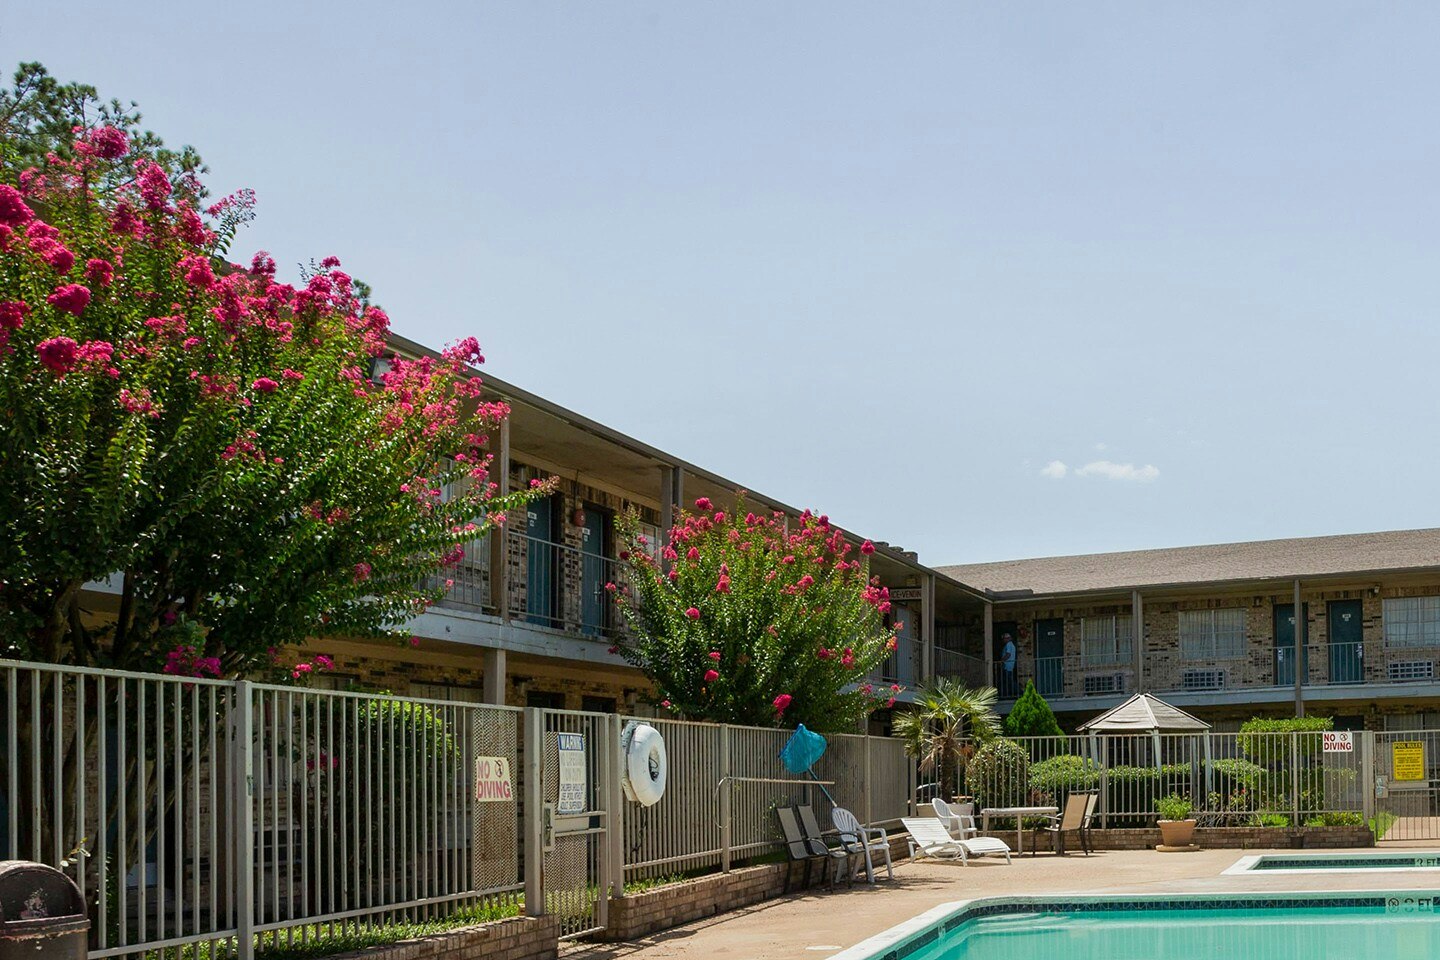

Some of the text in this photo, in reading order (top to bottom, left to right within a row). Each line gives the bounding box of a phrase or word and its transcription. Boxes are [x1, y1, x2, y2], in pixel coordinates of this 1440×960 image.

[1324, 742, 1352, 750] DIVING
[478, 760, 490, 779] NO
[477, 780, 511, 799] DIVING
